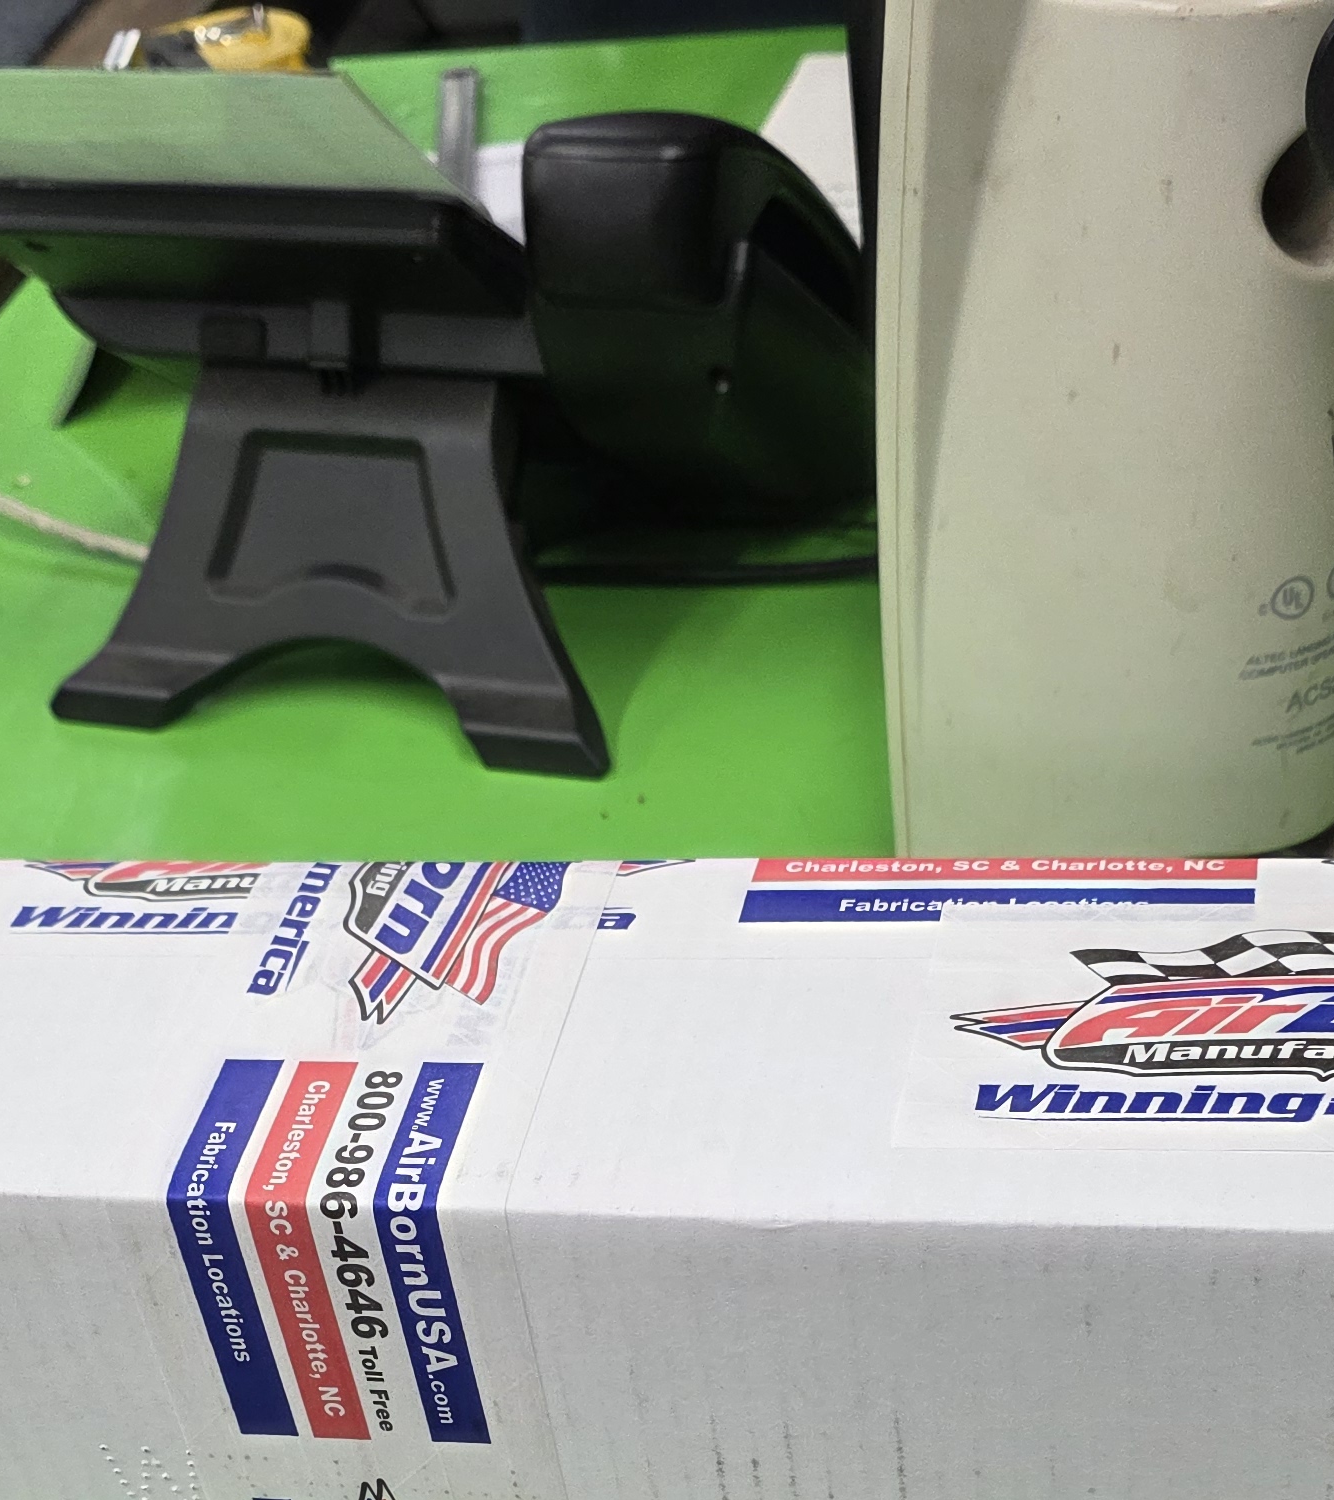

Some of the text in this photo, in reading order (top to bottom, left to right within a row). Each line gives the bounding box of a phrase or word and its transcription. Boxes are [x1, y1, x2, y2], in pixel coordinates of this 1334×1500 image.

[785, 859, 1225, 874] Charleston, SC & Charlotte, NC
[186, 1120, 251, 1364] Fabrication Locations
[974, 1083, 1326, 1122] Winning
[261, 1079, 346, 1418] Charleston, SC & Charlotte, NC
[319, 1069, 404, 1433] 800-986-4646 Toll Free
[387, 1078, 459, 1426] www.AirBornUSA.com
